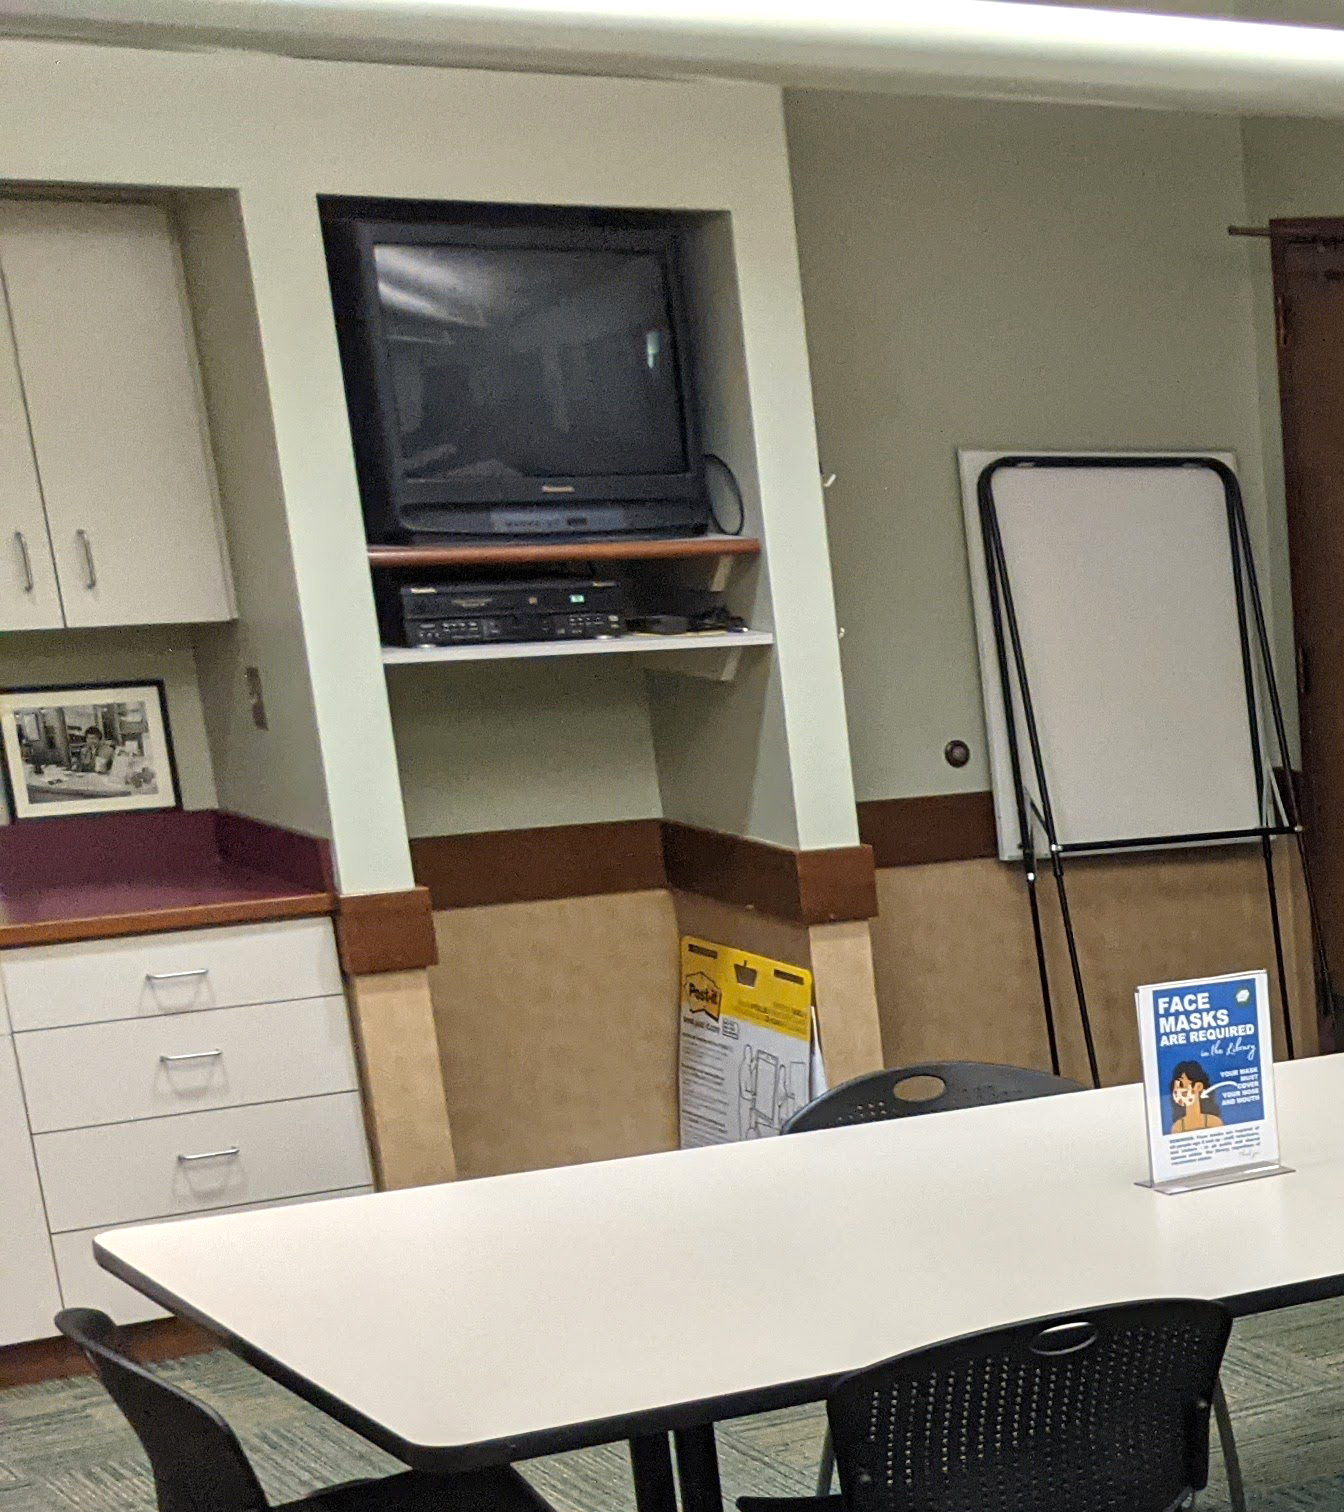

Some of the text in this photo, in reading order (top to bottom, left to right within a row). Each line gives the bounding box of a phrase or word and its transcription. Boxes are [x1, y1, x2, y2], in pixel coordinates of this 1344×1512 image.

[1158, 992, 1210, 1014] FACE
[1159, 1009, 1229, 1034] MASKS
[1160, 1023, 1255, 1047] ARE REQUIRED
[1200, 1049, 1210, 1057] in
[1211, 1039, 1223, 1056] the
[1220, 1069, 1239, 1078] YOUR
[1236, 1081, 1259, 1090] COVER
[1222, 1090, 1241, 1099] YOUR
[1221, 1098, 1236, 1106] AND
